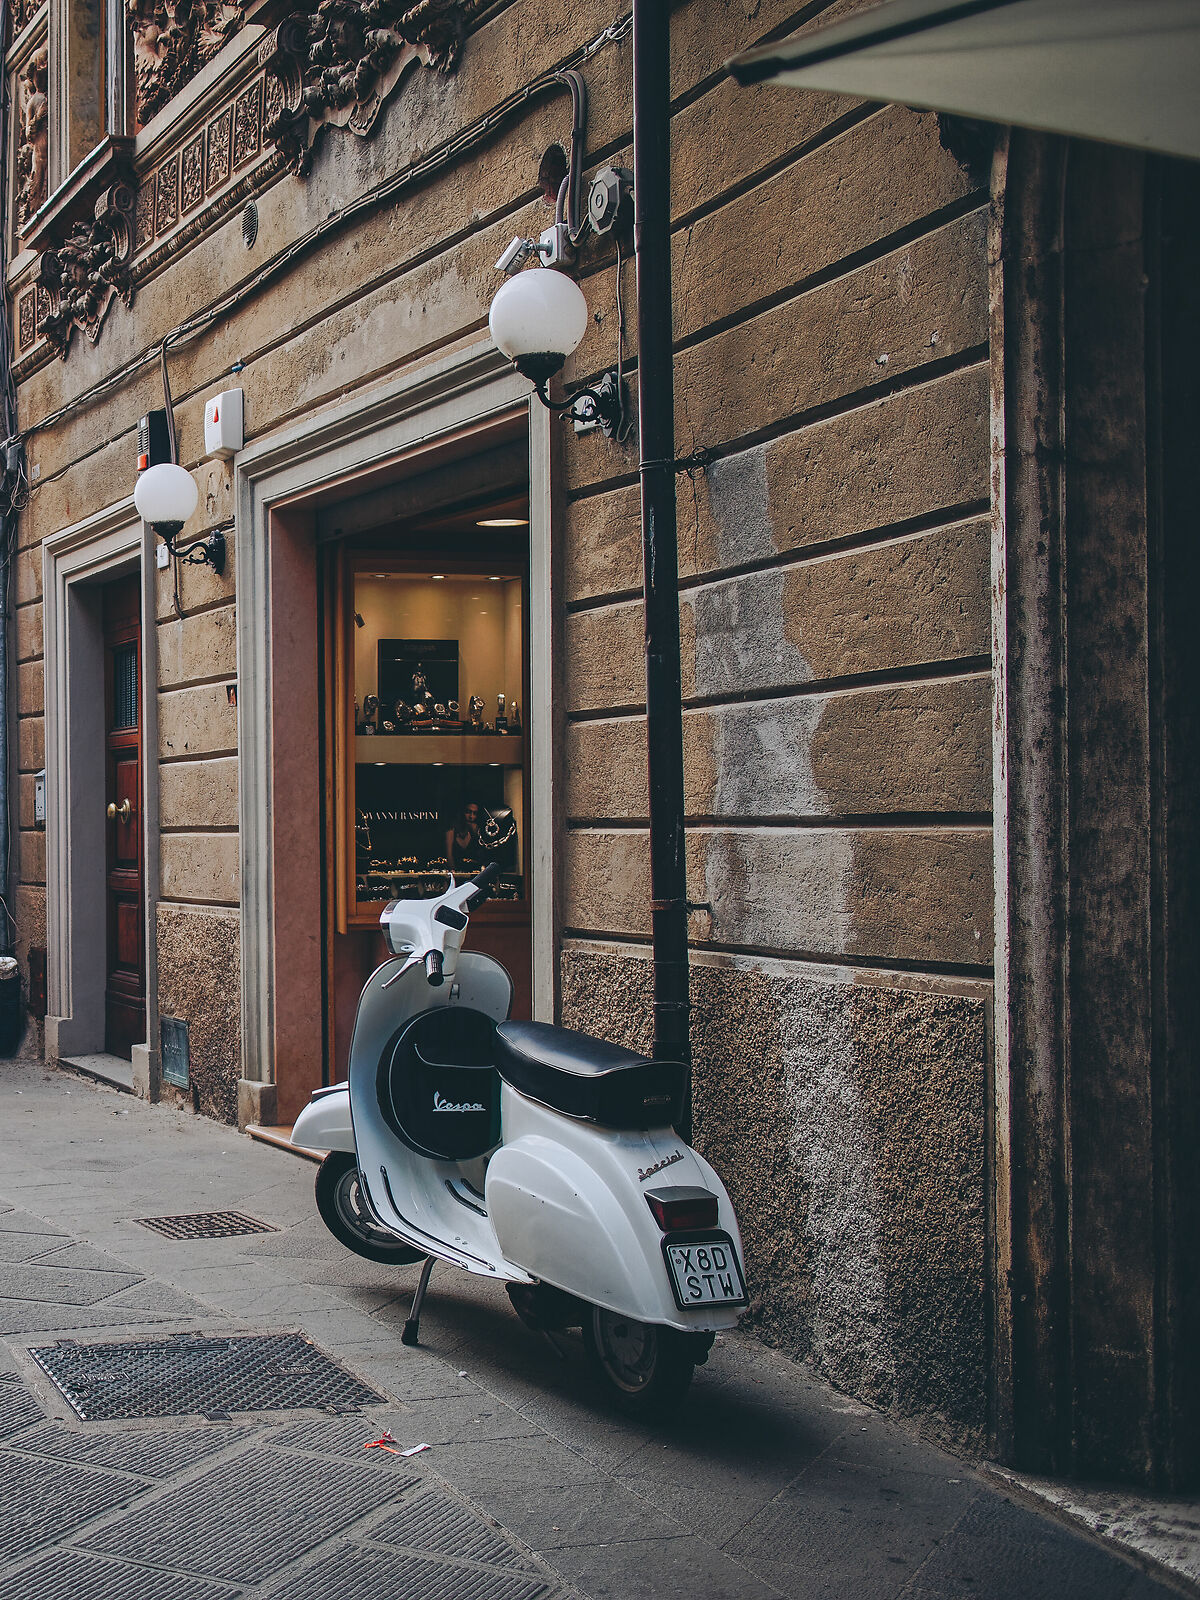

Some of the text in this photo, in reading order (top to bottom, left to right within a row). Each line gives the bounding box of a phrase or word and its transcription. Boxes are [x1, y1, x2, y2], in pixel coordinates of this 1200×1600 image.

[400, 811, 439, 820] RASPINI
[433, 1090, 486, 1113] Vespa
[637, 1150, 685, 1182] Special
[678, 1247, 728, 1273] X8D
[686, 1273, 735, 1299] STW
